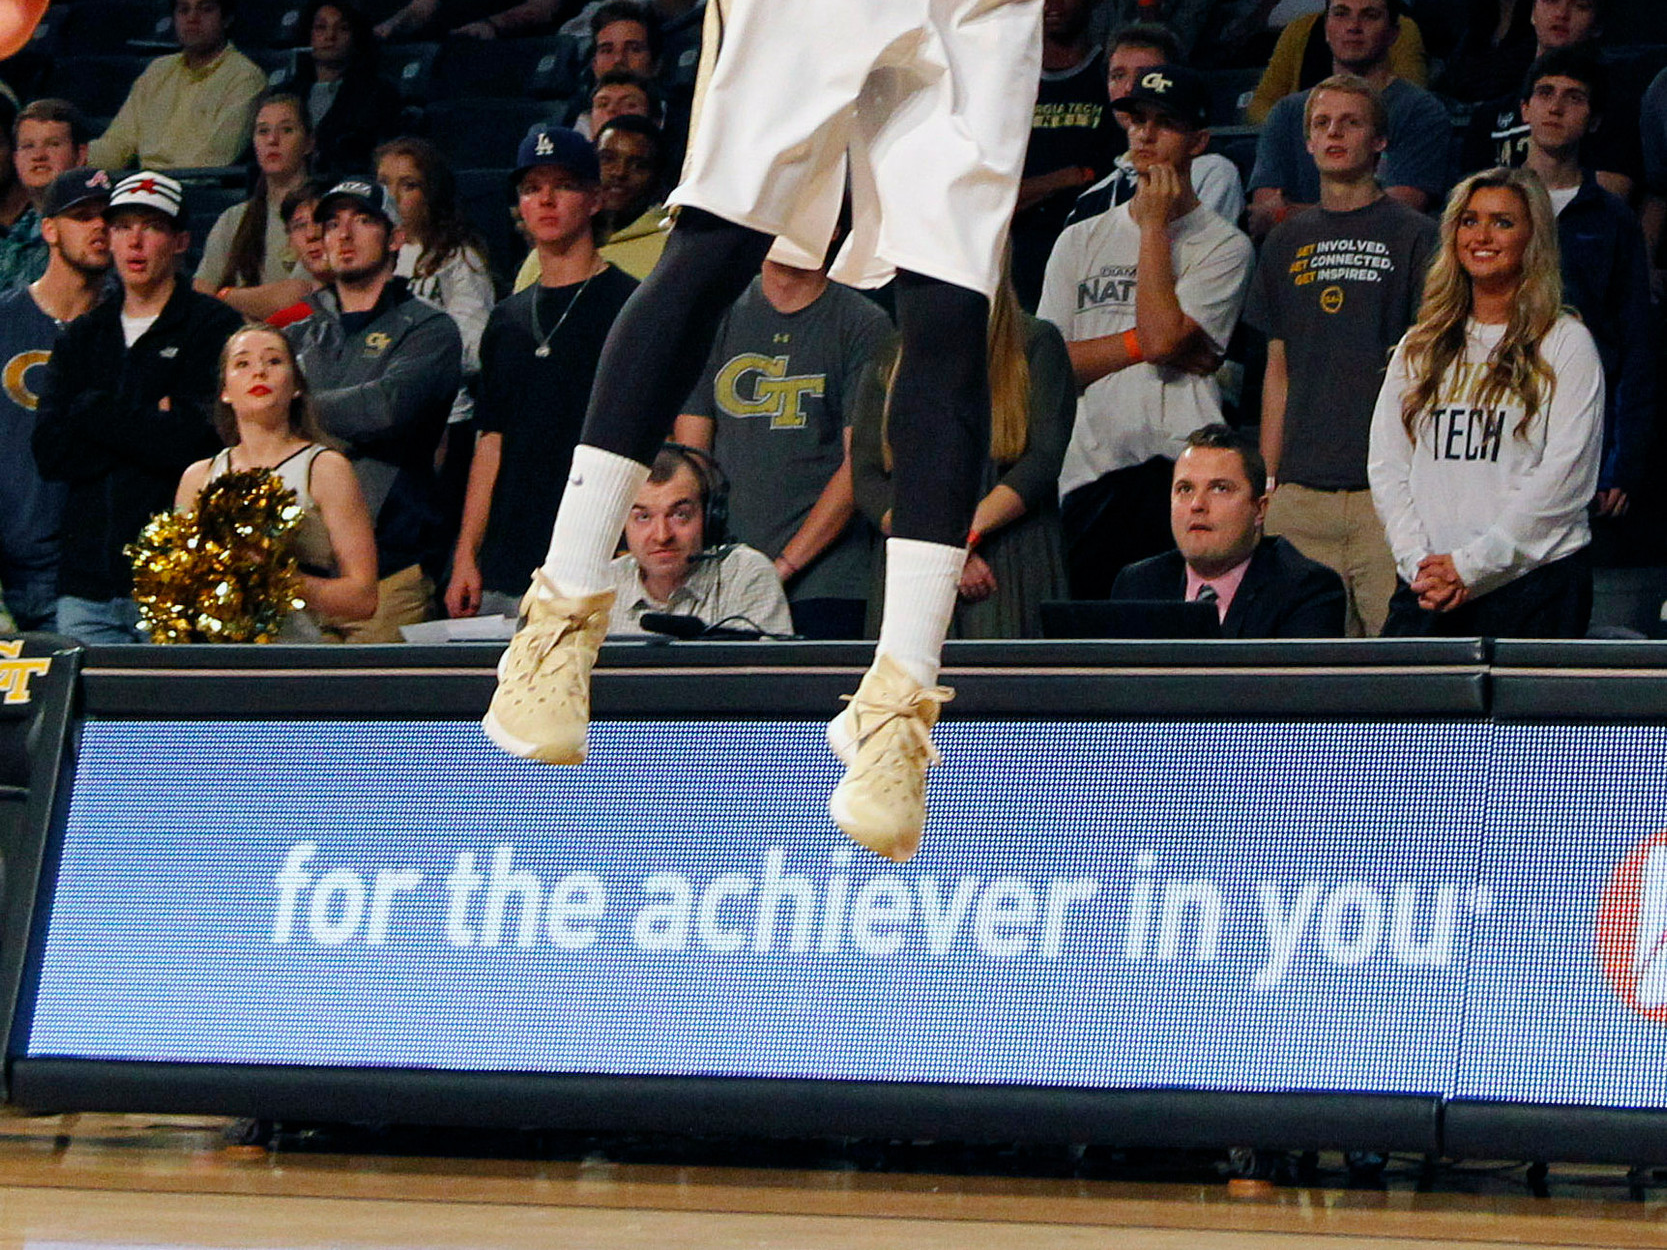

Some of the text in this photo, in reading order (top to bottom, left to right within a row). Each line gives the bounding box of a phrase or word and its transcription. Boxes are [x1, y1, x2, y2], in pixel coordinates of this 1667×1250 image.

[534, 133, 554, 156] LA
[713, 352, 826, 430] GT
[1430, 408, 1506, 462] TECH
[272, 838, 424, 947] for
[446, 842, 607, 950] the
[632, 846, 1098, 958] achiever
[1126, 849, 1222, 961] in
